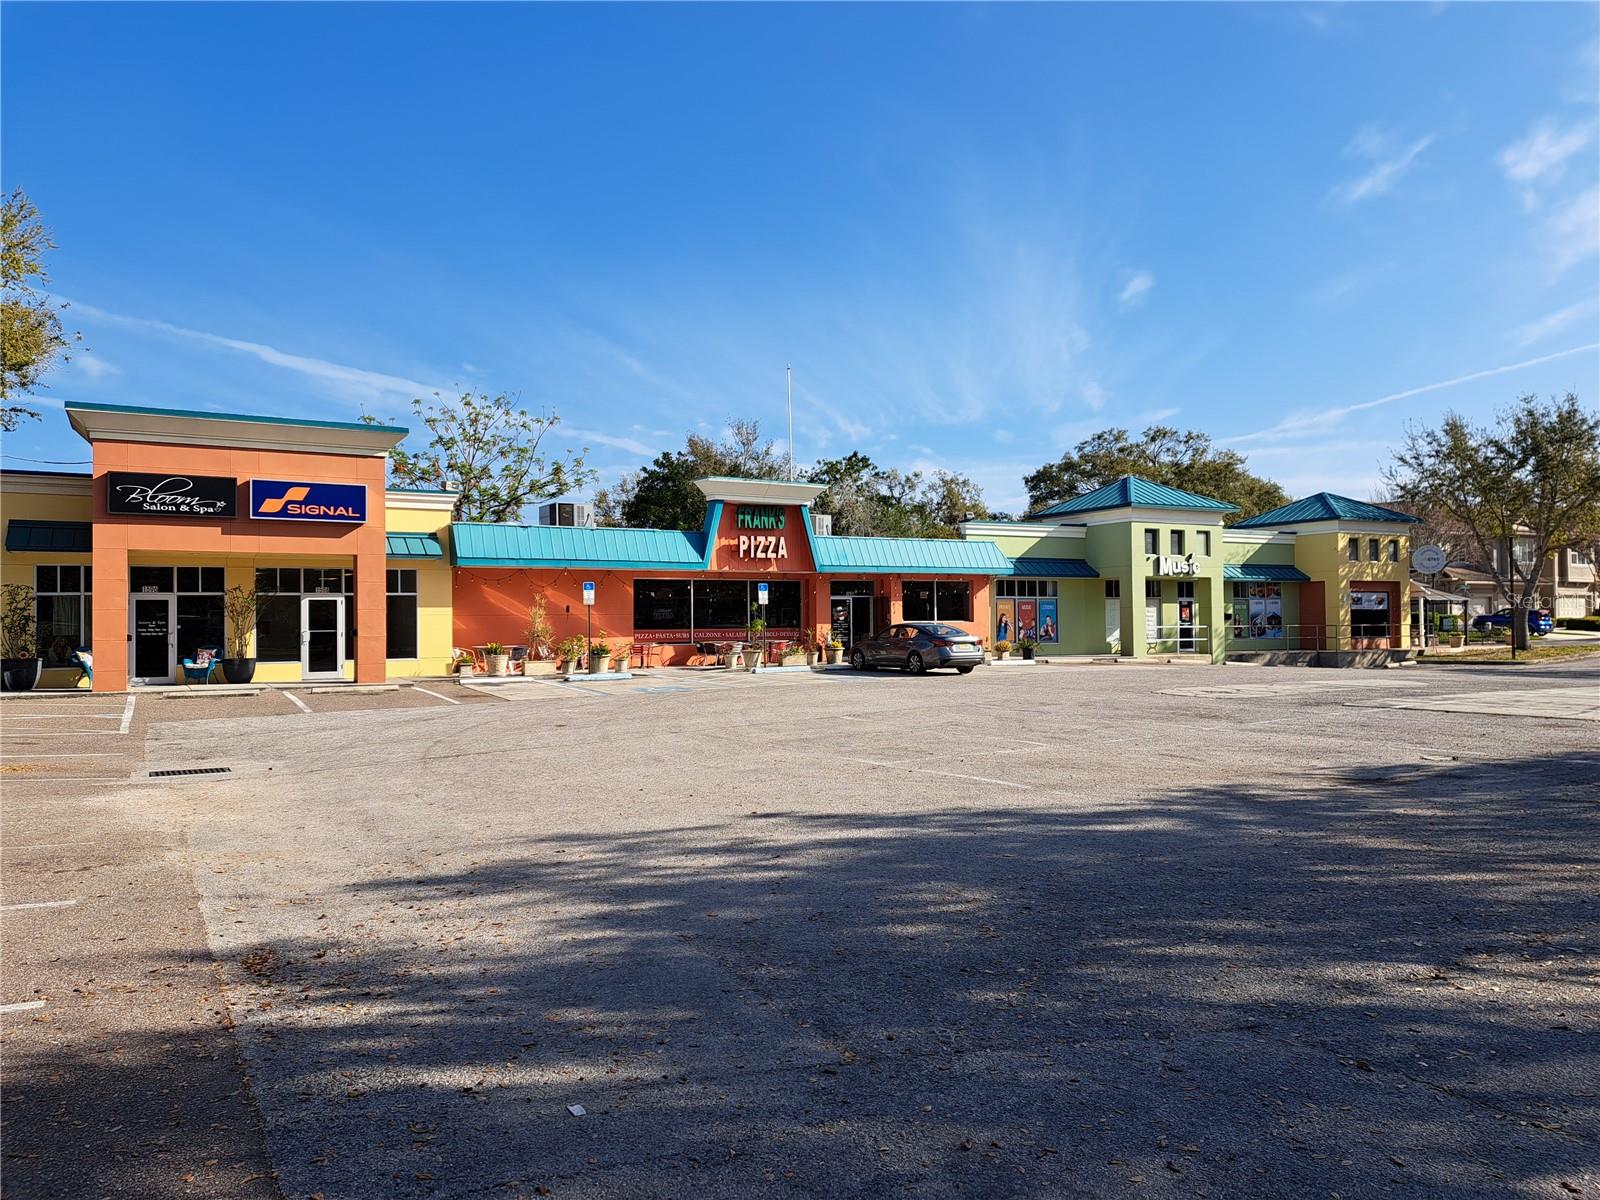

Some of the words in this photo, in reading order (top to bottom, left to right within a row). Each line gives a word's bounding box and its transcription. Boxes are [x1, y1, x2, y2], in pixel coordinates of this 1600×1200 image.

[116, 477, 205, 505] Bloom
[142, 503, 176, 512] Salon
[180, 504, 190, 512] &
[193, 505, 215, 514] Spa
[287, 504, 360, 517] SIGNAL
[736, 506, 785, 529] FRANK'S
[739, 535, 788, 559] PIZZA
[1159, 553, 1200, 576] Music
